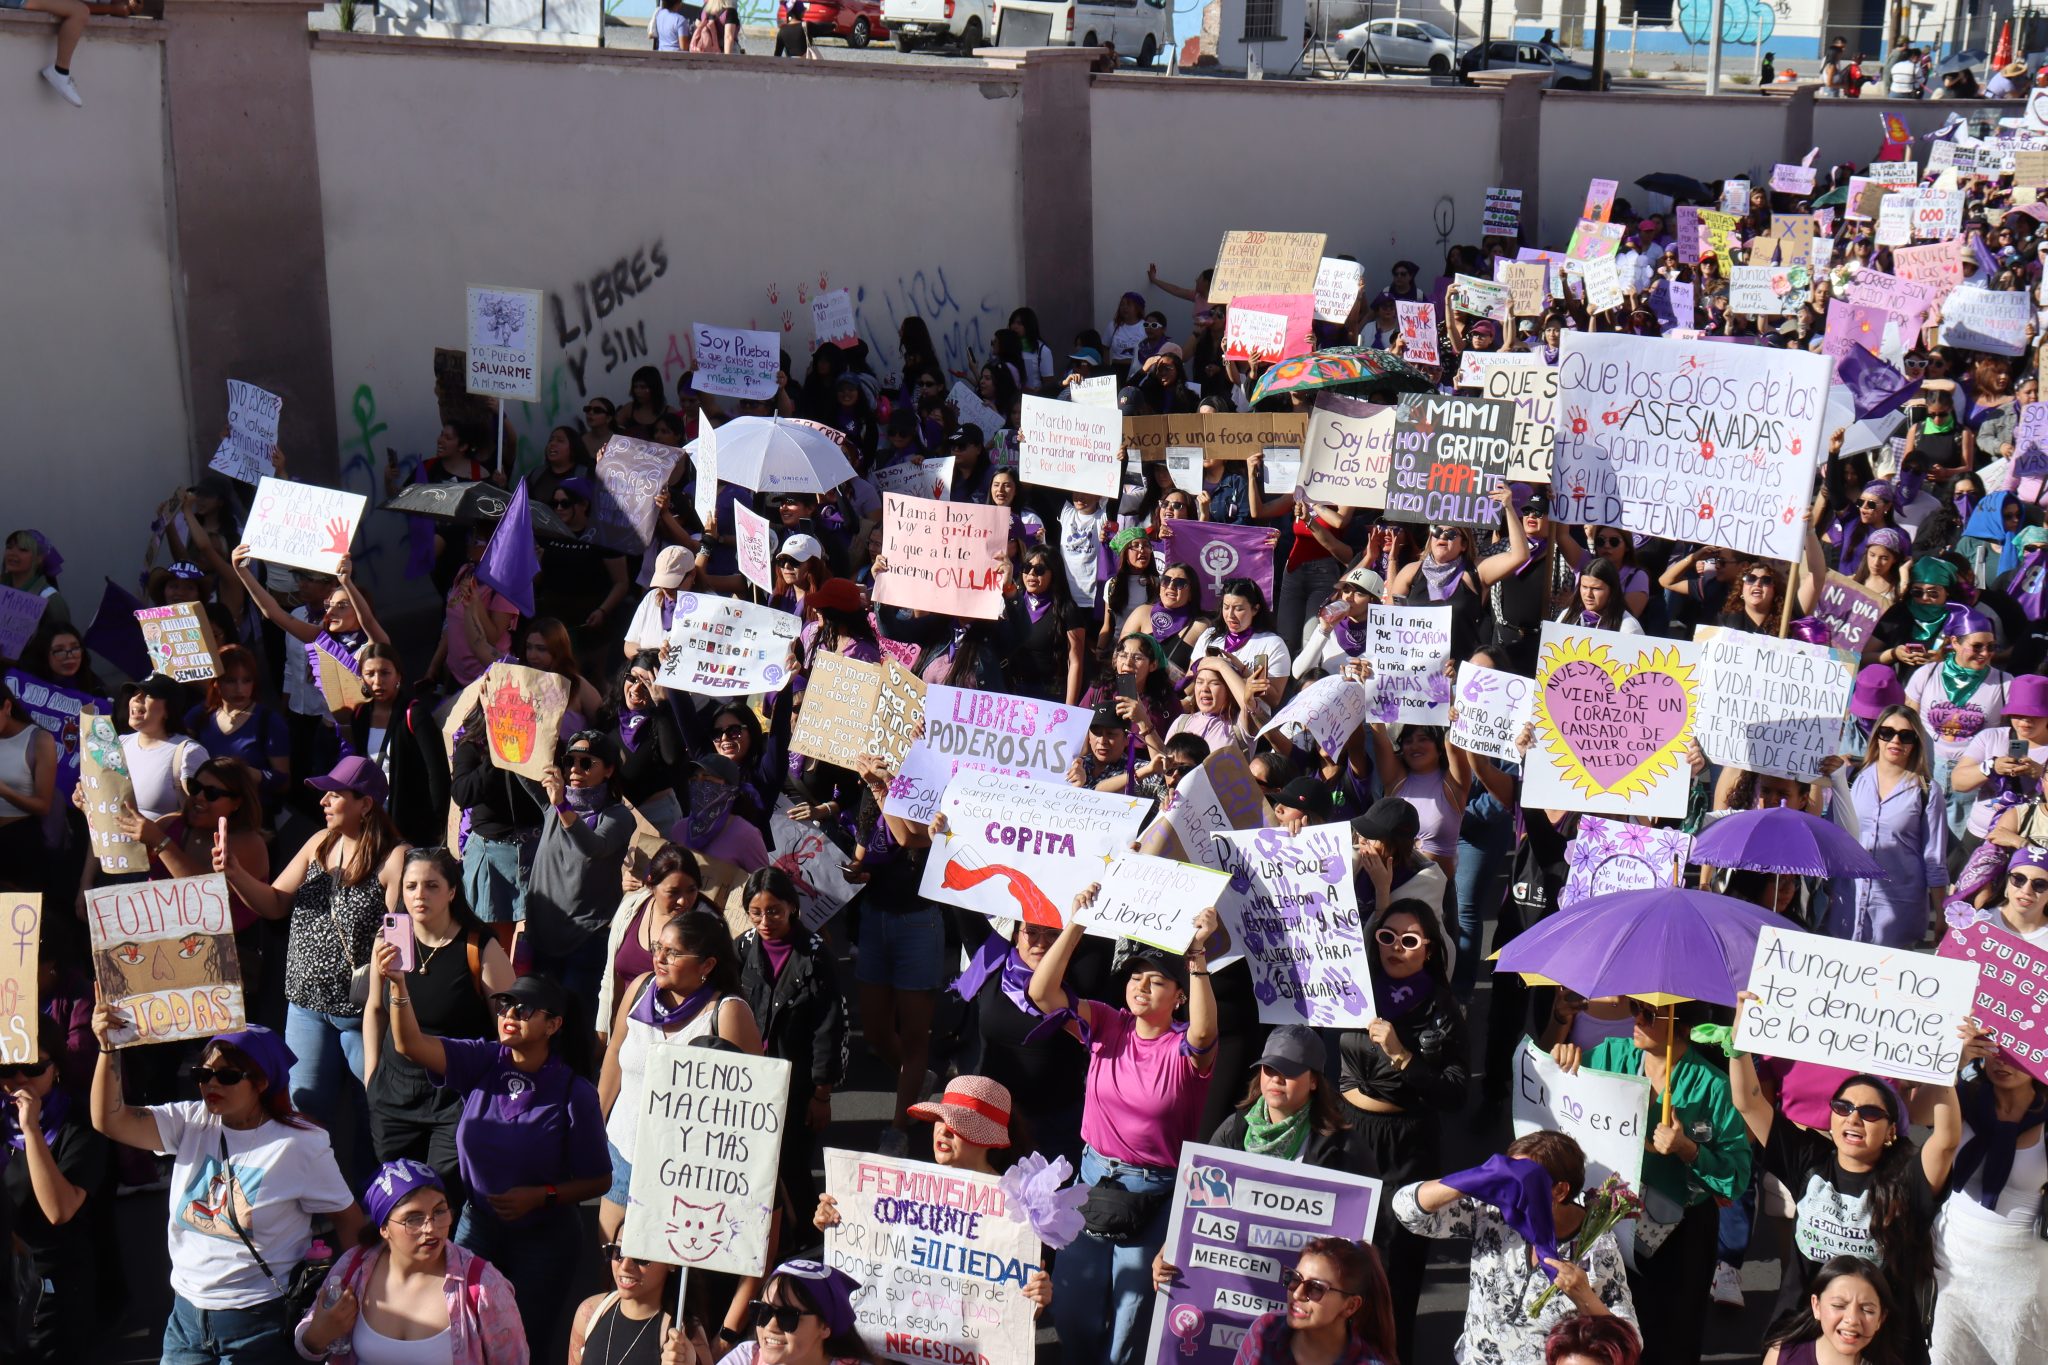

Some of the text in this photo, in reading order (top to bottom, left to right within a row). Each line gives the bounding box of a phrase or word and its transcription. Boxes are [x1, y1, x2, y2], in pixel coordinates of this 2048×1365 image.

[1244, 232, 1267, 244] 2025
[1508, 267, 1525, 278] SIN
[551, 238, 668, 350] LIBRES
[1907, 283, 1927, 299] SIN
[700, 330, 770, 358] Soy Prueba
[491, 350, 527, 363] PUEDO
[564, 319, 648, 397] Y SIN
[708, 353, 779, 371] que existe algo
[472, 362, 532, 380] SALVARME
[1489, 371, 1532, 398] QUE
[1624, 361, 1817, 421] los de las
[1035, 412, 1106, 436] Marcho hoy con
[1426, 400, 1500, 431] MAMI
[1620, 399, 1784, 454] ASESINADAS
[1029, 427, 1111, 452] mis para
[1168, 427, 1252, 444] es una fosa
[1323, 422, 1379, 457] Soy la
[2024, 425, 2041, 438] DE
[1396, 432, 1509, 463] HOY GRITO
[1654, 444, 1669, 467] a
[1039, 461, 1055, 472] Por
[1334, 454, 1360, 473] las
[1394, 452, 1416, 471] LO
[1355, 476, 1377, 487] vas
[1397, 470, 1429, 489] QUE
[1557, 465, 1571, 485] Y
[889, 498, 973, 527] Mamá hoy
[1386, 491, 1502, 524] HIZO CALLAR
[898, 520, 992, 545] voy a gritar
[903, 542, 971, 561] que a te
[1824, 585, 1880, 623] NI UNA
[1391, 610, 1432, 629] la niña
[1375, 628, 1391, 642] que
[1374, 643, 1442, 659] pero la de
[174, 667, 214, 682] SEMILLAS
[1377, 658, 1427, 675] la niña que
[1546, 660, 1675, 695] NUESTRO GRITO
[1714, 644, 1848, 688] QUE MUJER DE
[692, 673, 750, 689] FUERTE
[832, 676, 860, 696] POR
[1376, 673, 1423, 692] JAMAS
[1714, 671, 1846, 715] VIDA TENDRIAN
[810, 683, 868, 709] mi abuela
[1400, 696, 1427, 708] tocar
[1561, 686, 1682, 713] VIENE DE UN
[801, 712, 832, 731] HIJA
[951, 690, 1040, 737] LIBRES
[1457, 700, 1515, 730] QUIERO QUE
[1574, 704, 1646, 724] CORAZON
[1781, 708, 1822, 733] PARA
[1472, 724, 1515, 741] SEPA QUE
[1561, 721, 1664, 742] CANSADO DE
[1709, 714, 1825, 753] TE PREOCUPE LA
[926, 718, 1068, 774] PODEROSAS
[1471, 739, 1515, 758] CAMBIAR AL
[1576, 739, 1657, 753] VIVIR CON
[1763, 745, 1781, 768] DE
[1582, 754, 1638, 768] MIEDO
[977, 773, 1046, 796] Que la
[908, 803, 933, 821] QUE
[960, 787, 1131, 821] sangre que se derrame
[963, 803, 1111, 833] sea la de nuestra
[984, 821, 1076, 858] COPITA
[1260, 859, 1329, 879] LAS QUE
[1327, 884, 1339, 903] A
[92, 879, 225, 941] FUIMOS
[1332, 909, 1360, 928] NO
[1315, 942, 1352, 961] PARA
[1764, 937, 1940, 999] Aunque no
[1760, 974, 1797, 1009] te
[118, 986, 232, 1037] TODAS
[1976, 992, 2024, 1024] MAS
[1788, 1016, 1960, 1075] lo que hiciste
[672, 1059, 753, 1093] MENOS
[649, 1090, 779, 1134] MACHITOS
[1562, 1094, 1638, 1138] no es el
[680, 1125, 694, 1153] Y
[659, 1158, 750, 1197] GATITOS
[856, 1162, 1006, 1218] FEMINISMO
[1251, 1190, 1324, 1216] TODAS
[873, 1196, 983, 1241] CONSCIENTE
[1197, 1218, 1237, 1241] LAS
[834, 1222, 1042, 1290] POR UNA SOCIEDAD
[1823, 1237, 1834, 1246] SU
[1838, 1242, 1874, 1254] PROPIA
[1194, 1249, 1271, 1274] MERECEN
[885, 1288, 905, 1301] su
[941, 1276, 980, 1298] quién
[1216, 1291, 1263, 1311] A SUS
[906, 1315, 980, 1339] según su
